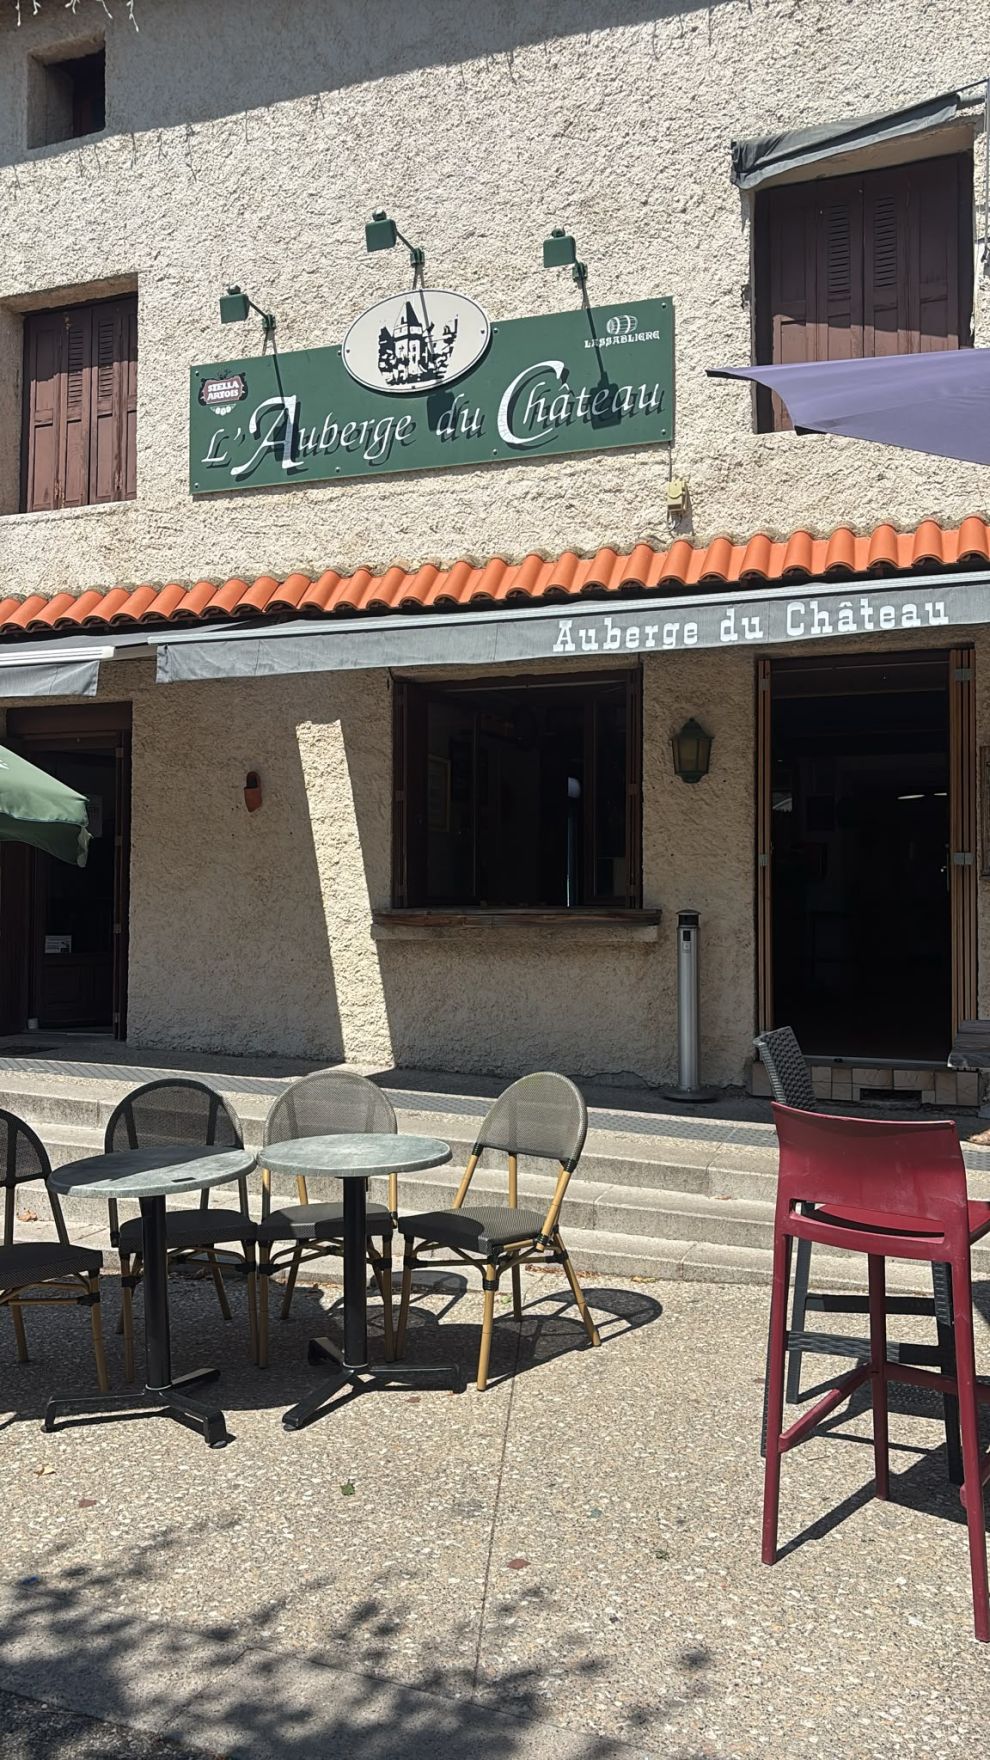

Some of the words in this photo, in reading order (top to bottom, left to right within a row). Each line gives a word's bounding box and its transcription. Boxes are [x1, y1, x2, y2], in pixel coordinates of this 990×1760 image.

[207, 380, 240, 393] STELLA
[207, 389, 239, 402] ARTOIS
[201, 394, 411, 476] L'Auberge
[435, 393, 481, 437] du
[496, 360, 660, 445] Château
[552, 618, 698, 653] Auberge
[720, 608, 764, 641] du
[785, 598, 949, 637] Château
